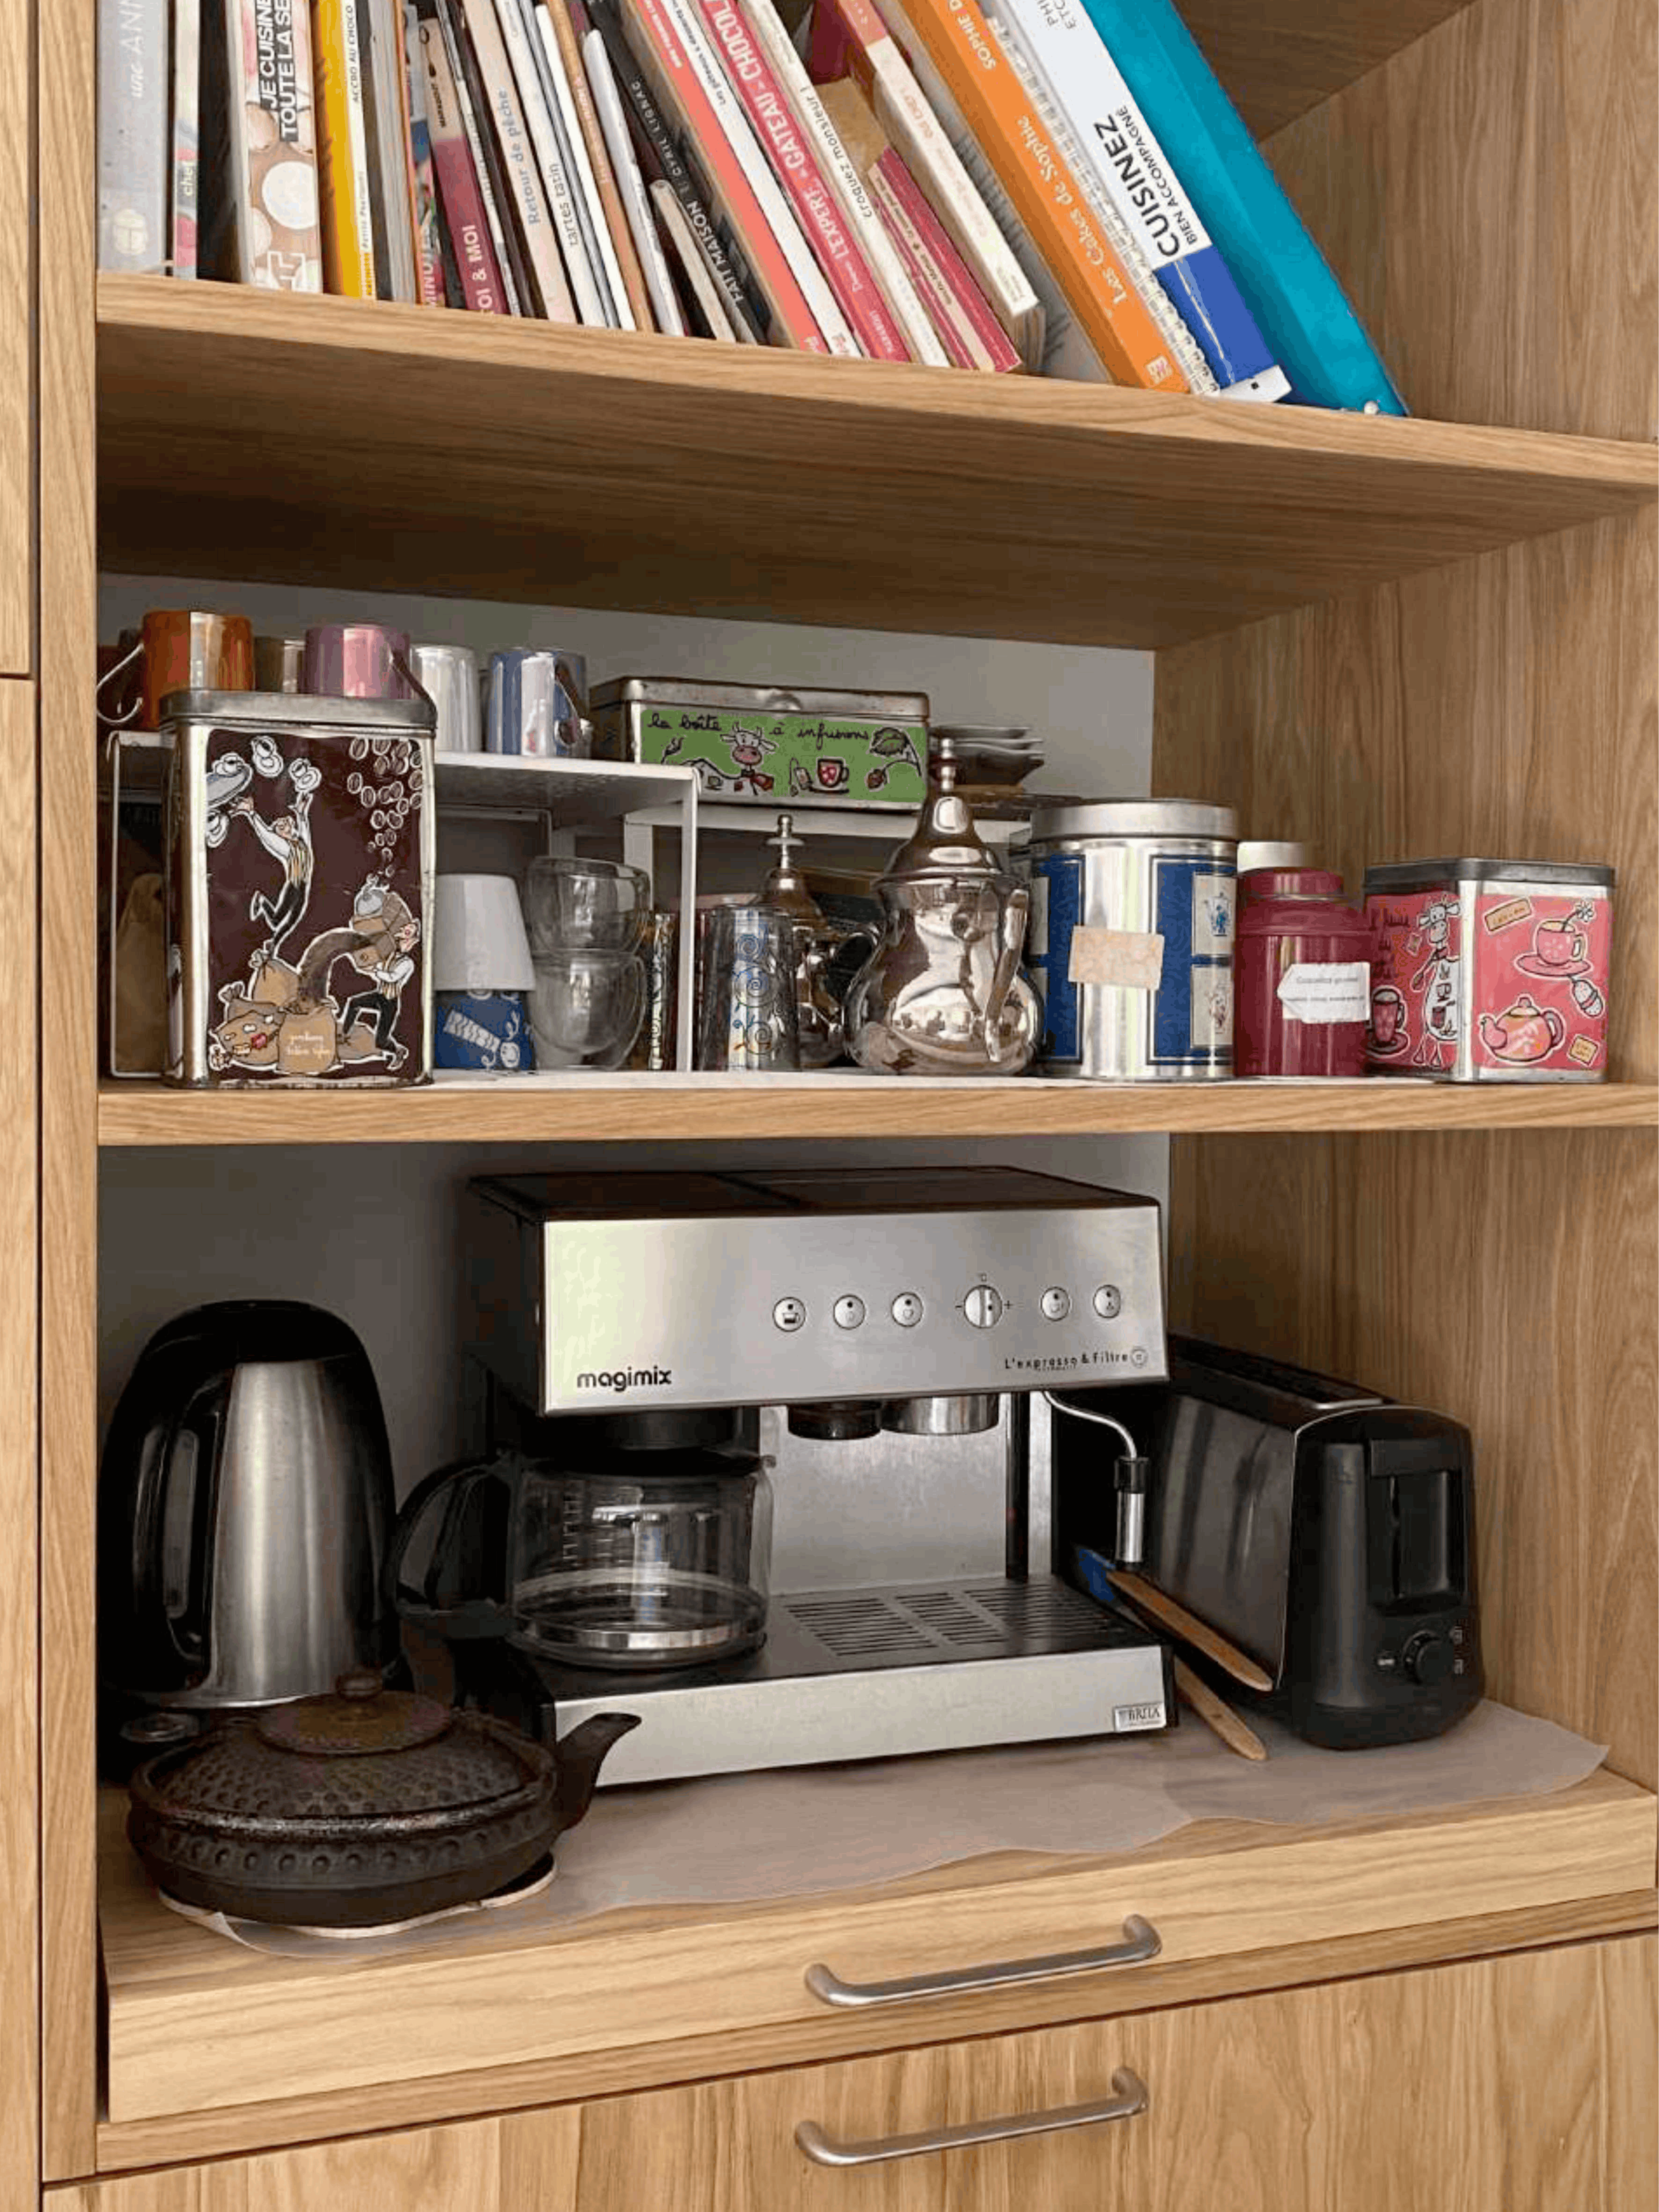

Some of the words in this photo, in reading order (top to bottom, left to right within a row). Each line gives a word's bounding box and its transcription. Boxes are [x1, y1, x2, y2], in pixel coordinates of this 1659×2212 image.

[276, 30, 293, 59] LA
[711, 0, 762, 80] CHOCOL
[957, 14, 996, 70] SOPHIE
[261, 79, 278, 108] JE
[277, 62, 297, 137] TOUTE
[493, 88, 521, 139] pêche
[631, 78, 660, 134] LIGNAC
[507, 141, 526, 165] de
[754, 92, 806, 170] GÂTEAU
[805, 95, 847, 164] monsieur
[1018, 116, 1058, 183] Sophie
[545, 161, 568, 198] tatin
[659, 139, 680, 176] CYRIL
[513, 168, 542, 226] Retour
[840, 162, 873, 218] croquez
[1055, 183, 1074, 206] de
[1094, 114, 1181, 257] CUISINEZ
[462, 225, 483, 263] MOI
[555, 200, 581, 248] tartes
[687, 199, 727, 266] MAISON
[1173, 210, 1197, 244] BIEN
[472, 268, 487, 281] &
[1102, 268, 1127, 306] Les
[647, 713, 673, 730] la
[769, 722, 785, 736] à
[577, 1364, 672, 1392] magimix
